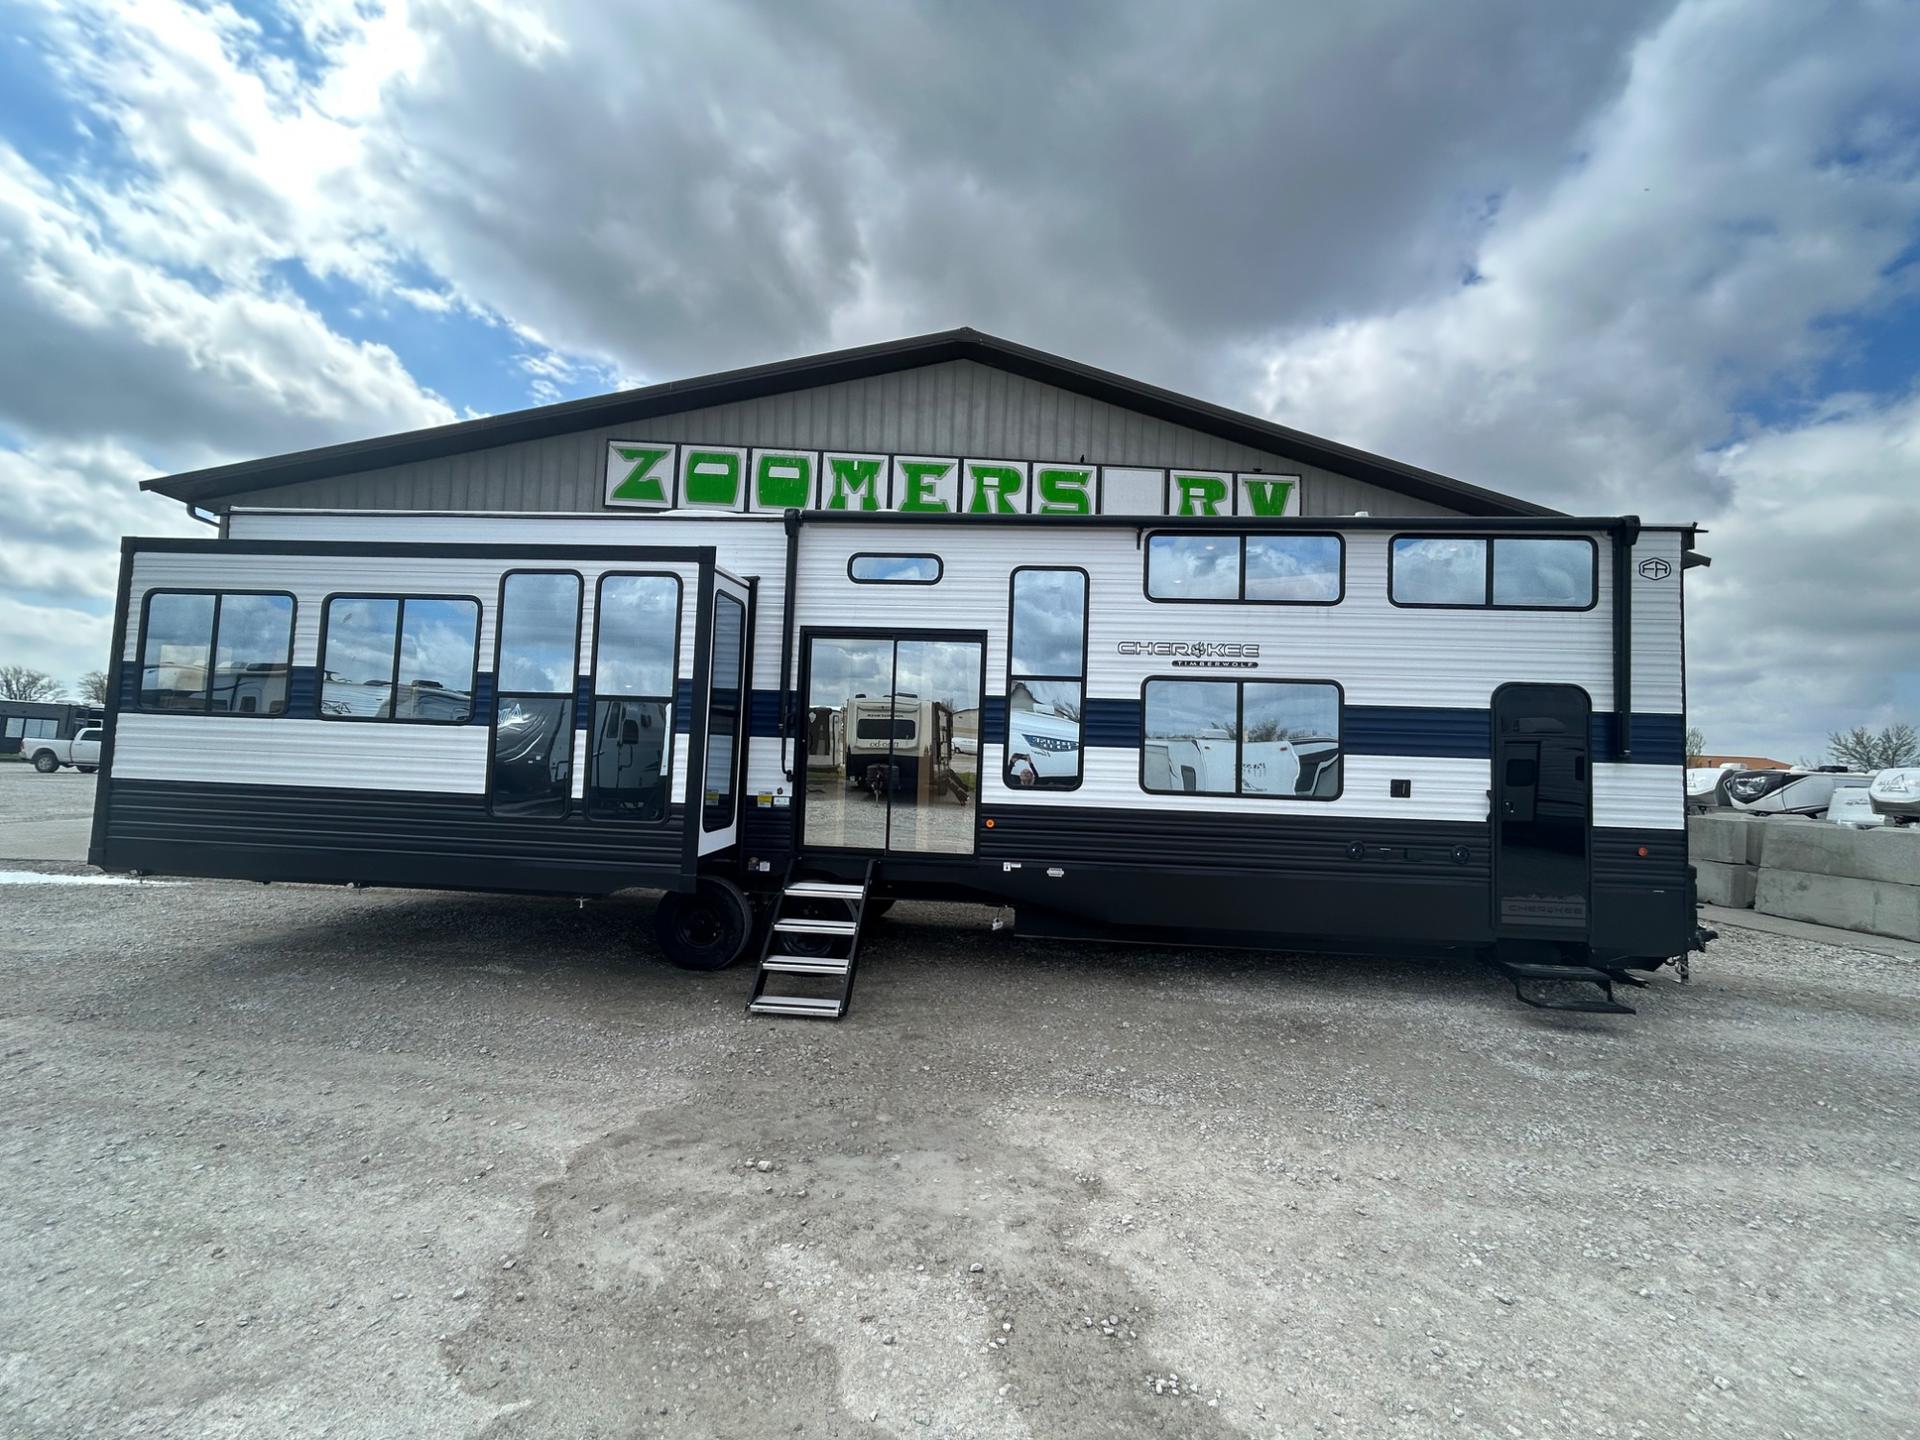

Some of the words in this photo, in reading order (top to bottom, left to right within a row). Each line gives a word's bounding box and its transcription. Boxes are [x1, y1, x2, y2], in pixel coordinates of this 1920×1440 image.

[610, 446, 1092, 514] ZOOMERS
[1174, 474, 1296, 516] RV
[1117, 641, 1260, 658] CHEROKEE
[1177, 660, 1254, 668] TIMBERWOLF
